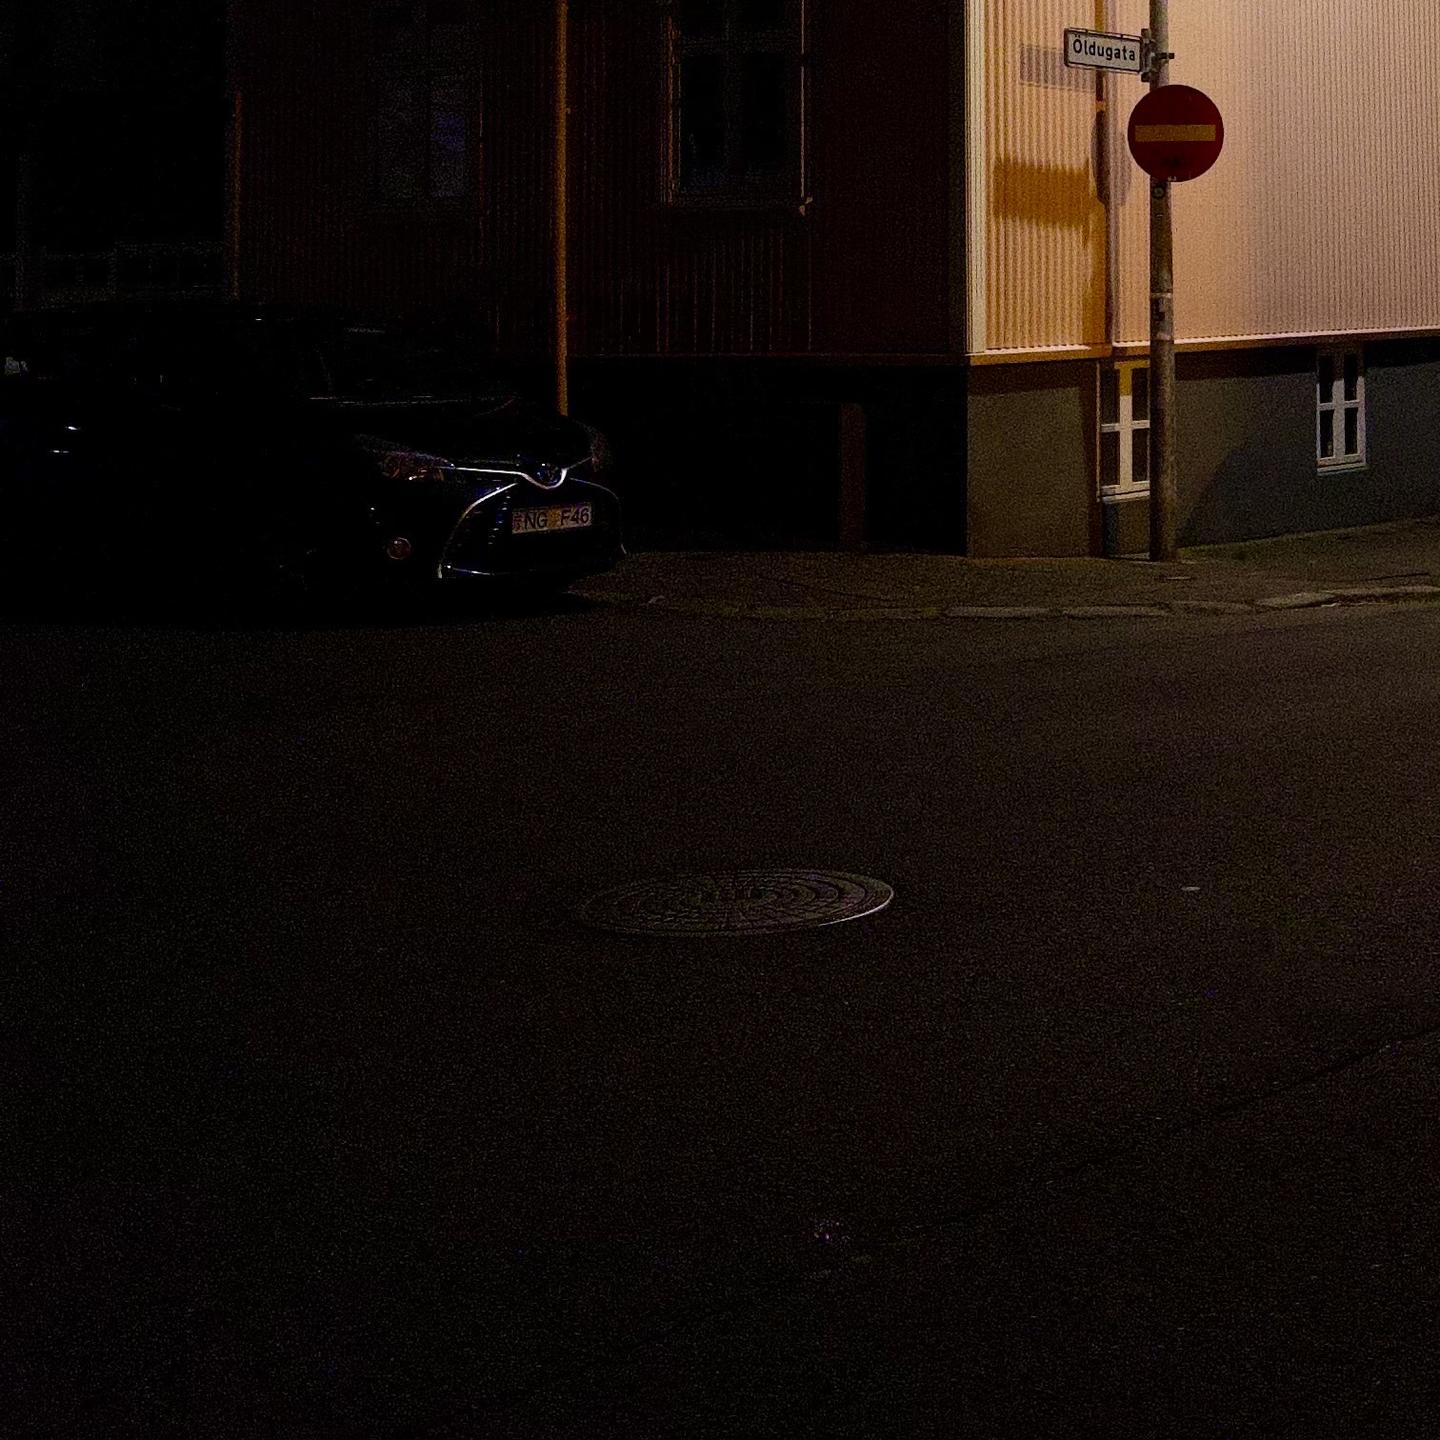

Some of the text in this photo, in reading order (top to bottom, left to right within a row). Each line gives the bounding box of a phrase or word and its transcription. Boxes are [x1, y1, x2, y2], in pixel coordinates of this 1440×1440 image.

[1073, 34, 1135, 61] Öldugata
[525, 507, 590, 530] NG F46
